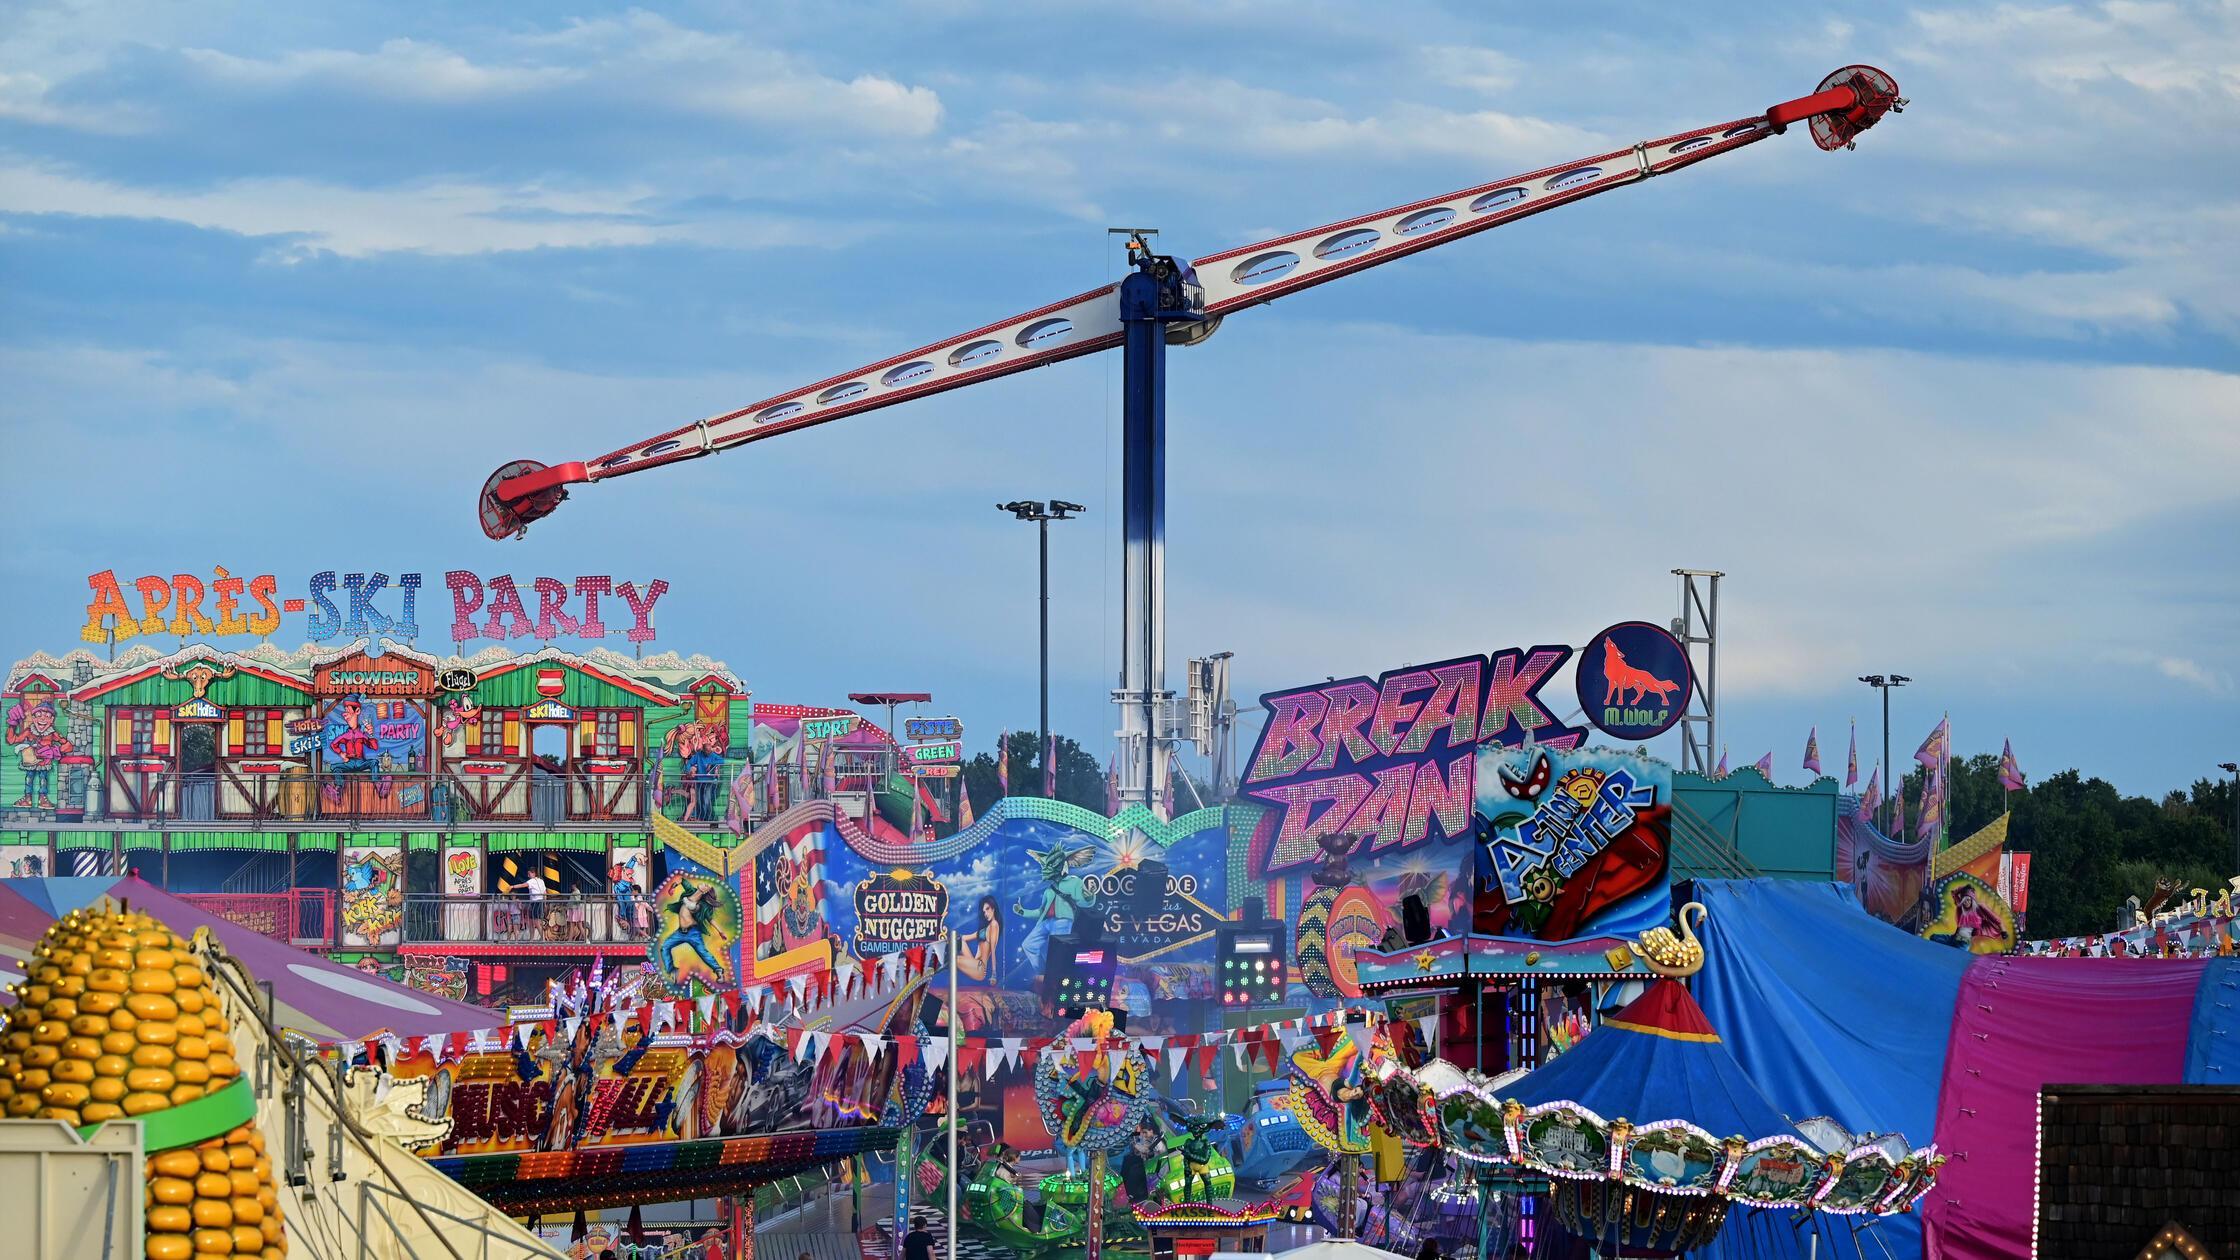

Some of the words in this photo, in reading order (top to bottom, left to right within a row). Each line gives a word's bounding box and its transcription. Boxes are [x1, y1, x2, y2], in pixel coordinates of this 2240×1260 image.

[445, 569, 669, 642] PARTY
[329, 670, 419, 686] SNOWBAR
[446, 672, 472, 690] Flügel
[294, 720, 323, 732] HOTEL
[1247, 651, 1565, 783] BREAK
[380, 723, 419, 740] PARTY
[806, 719, 850, 739] START
[915, 745, 956, 760] GREEN
[926, 767, 948, 776] RED
[1249, 750, 1477, 872] DAN
[1551, 768, 1657, 879] CENTER
[1487, 787, 1584, 905] ACTION
[864, 893, 938, 914] GOLDEN
[864, 918, 938, 940] NUGGET
[860, 941, 908, 953] GAMBLING
[1120, 936, 1172, 944] EVADA
[1170, 1207, 1215, 1217] KASSE
